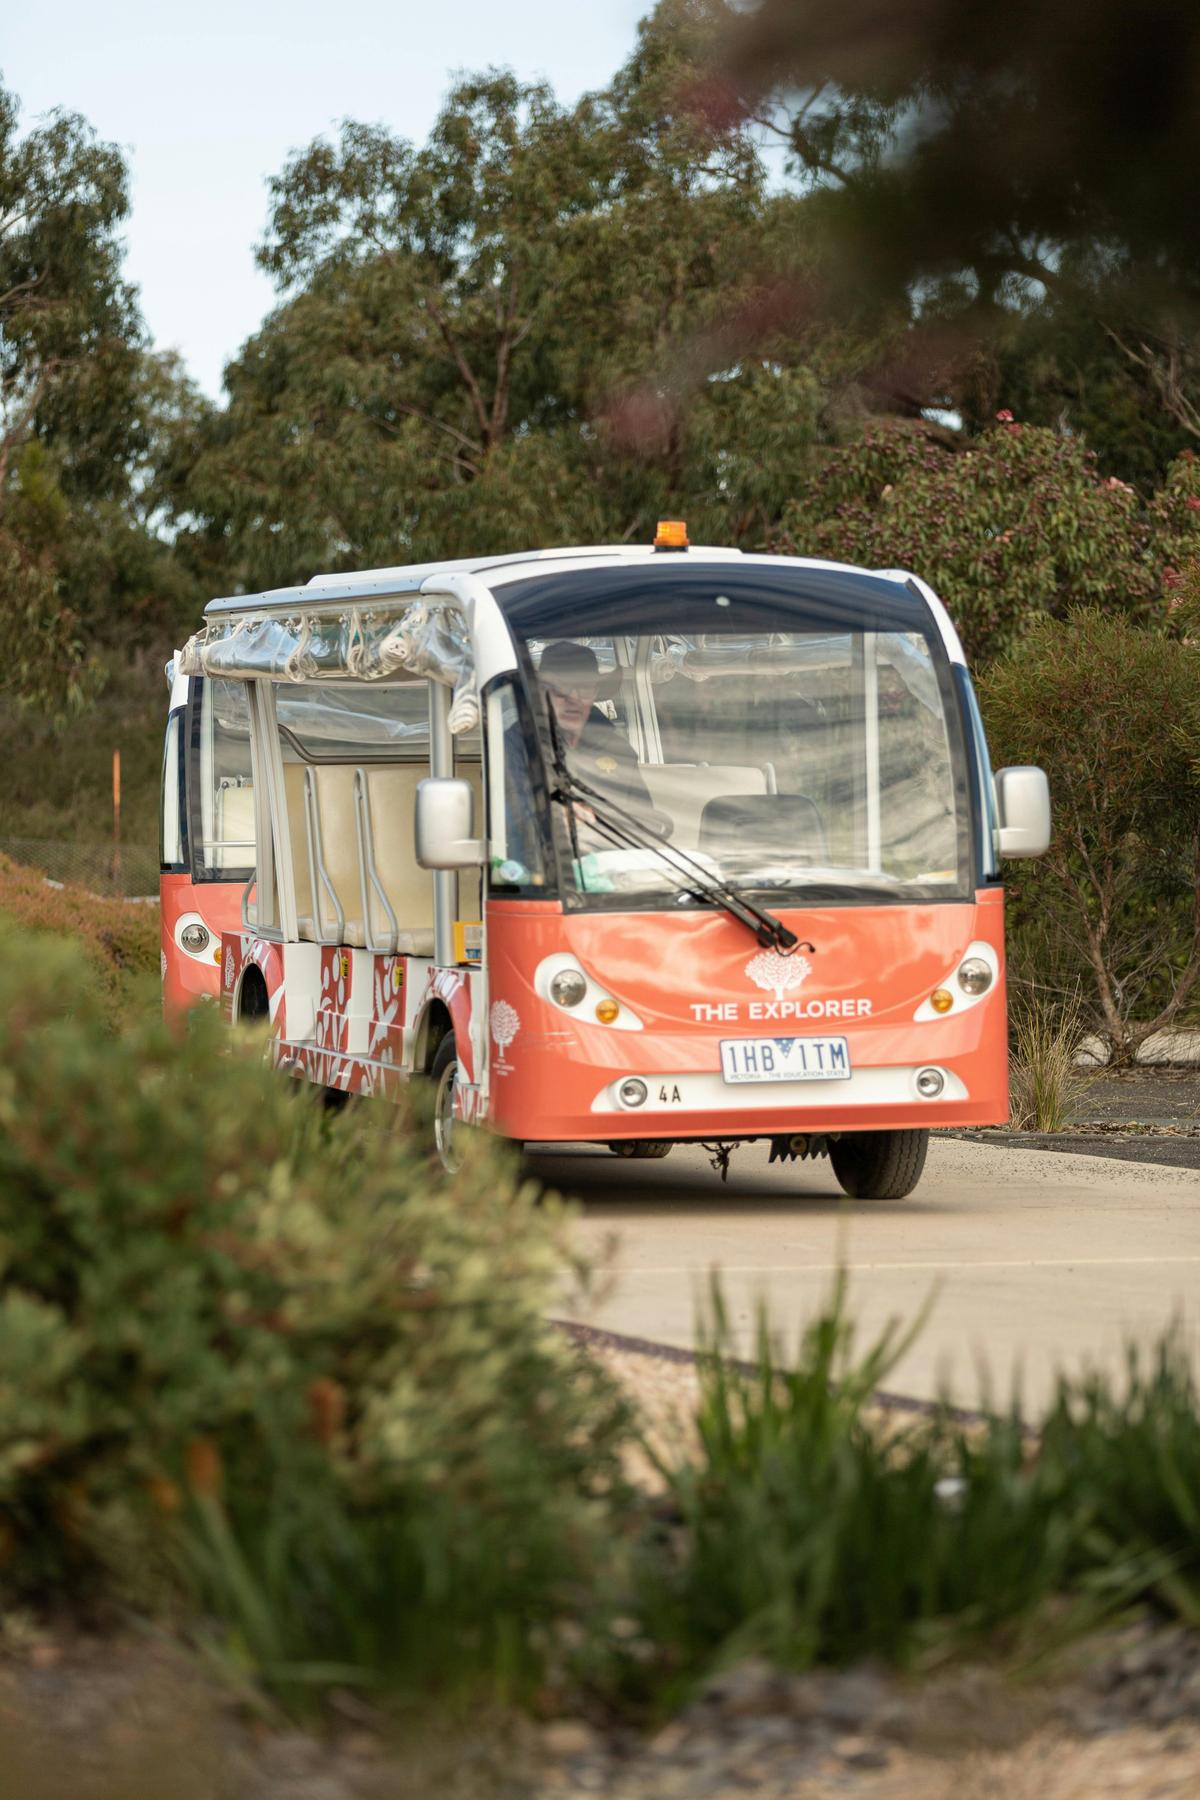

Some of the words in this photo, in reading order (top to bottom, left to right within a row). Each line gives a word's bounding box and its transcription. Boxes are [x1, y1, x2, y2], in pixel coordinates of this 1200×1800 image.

[690, 1003, 739, 1022] THE
[748, 998, 873, 1020] EXPLORER
[728, 1045, 775, 1073] 1HB
[798, 1042, 847, 1071] 1TM
